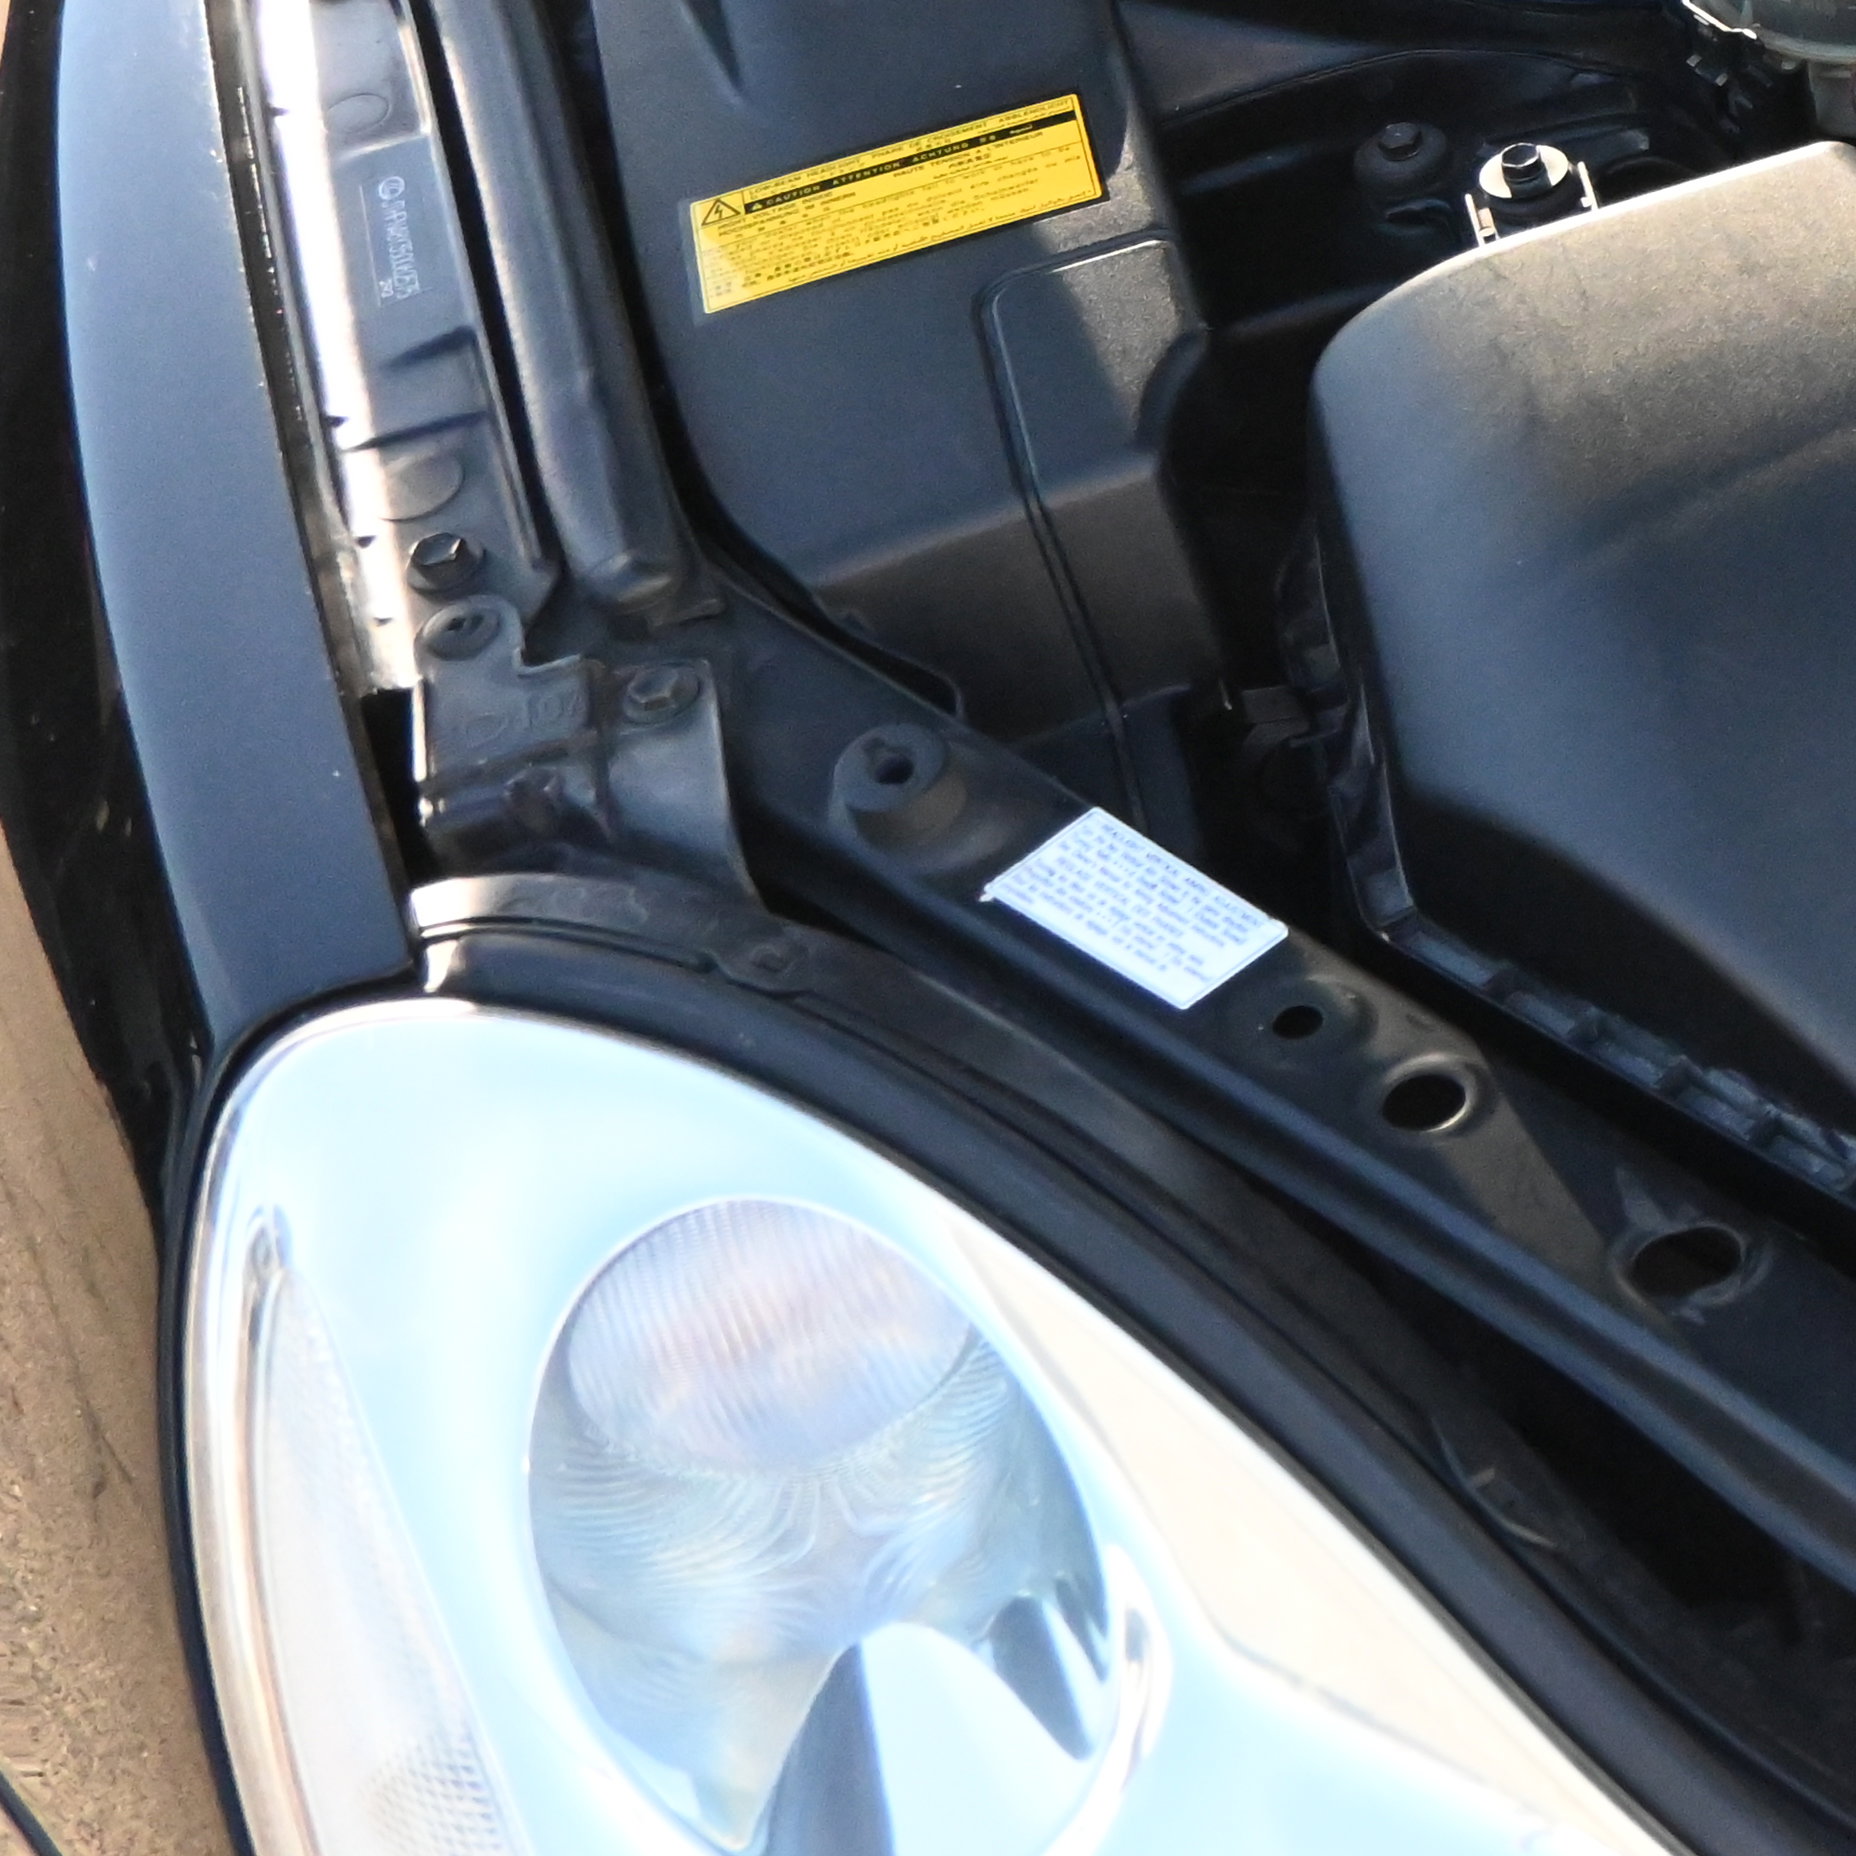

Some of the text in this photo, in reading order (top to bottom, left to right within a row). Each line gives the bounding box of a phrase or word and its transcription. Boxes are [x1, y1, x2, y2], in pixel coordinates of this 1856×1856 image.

[765, 141, 969, 205] CAUTION ATTENTION ACHTUNG
